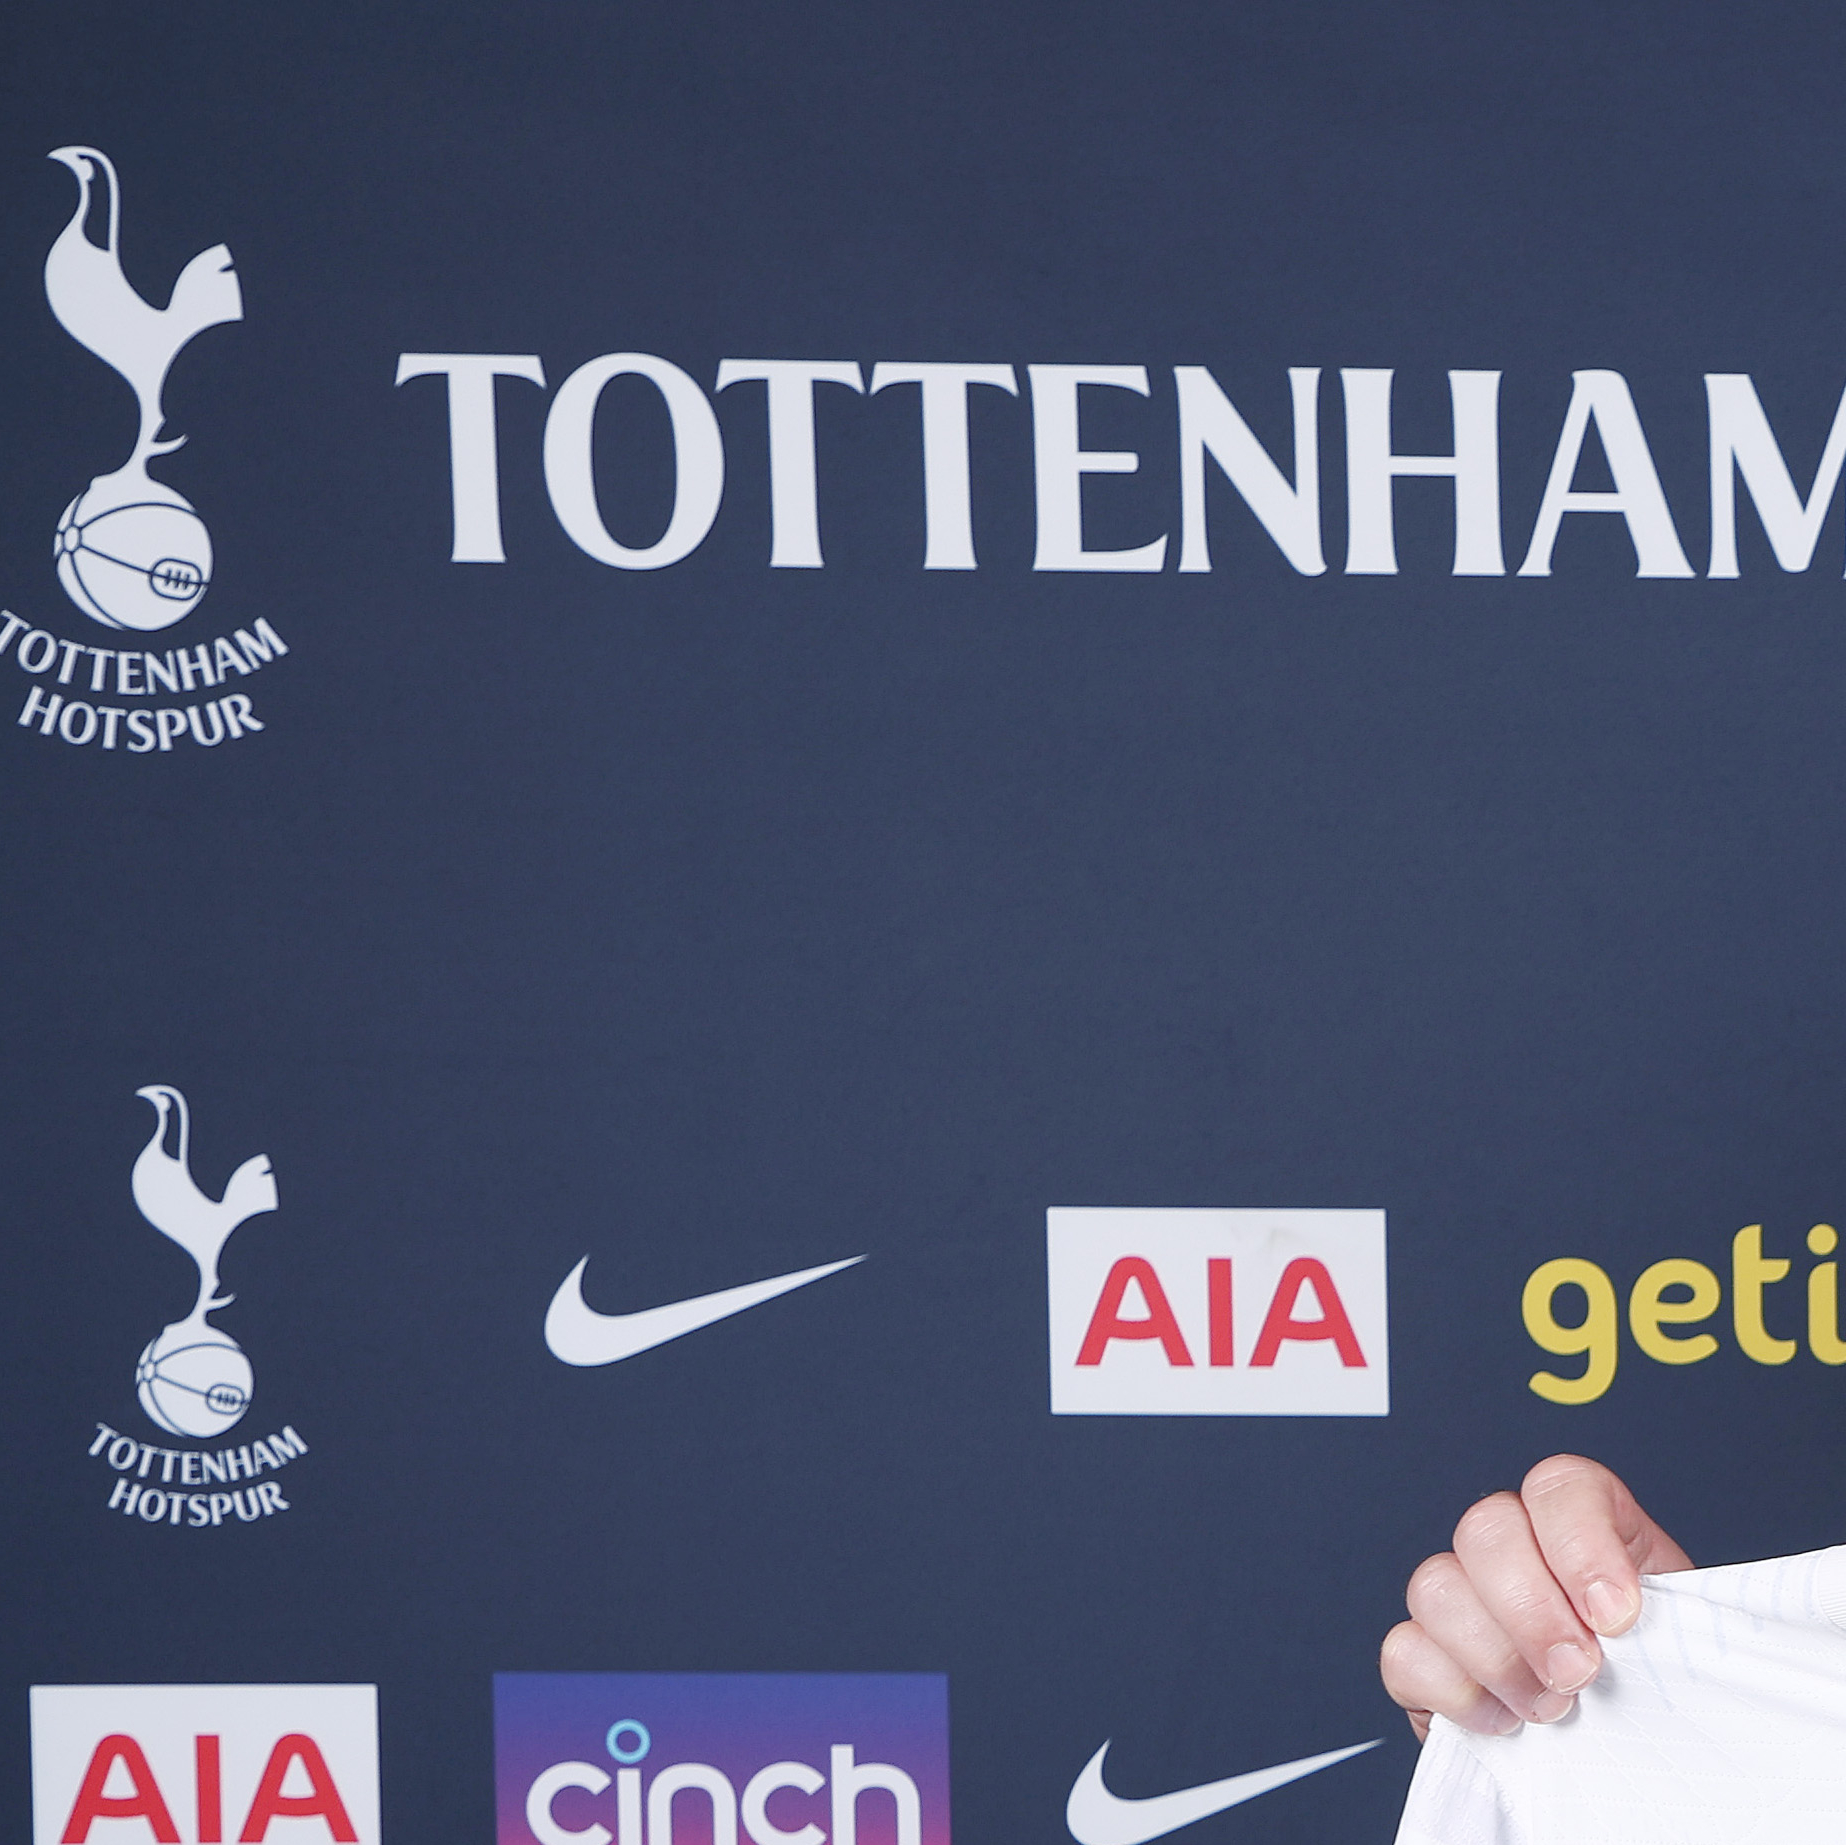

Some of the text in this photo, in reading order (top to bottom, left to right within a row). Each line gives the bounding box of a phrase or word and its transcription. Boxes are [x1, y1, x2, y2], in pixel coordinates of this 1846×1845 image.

[0, 609, 289, 696] TOTTENHAM
[17, 685, 265, 753] HOTSPUR
[1076, 1256, 1367, 1368] AIA
[88, 1422, 308, 1486] TOTTENHAM
[108, 1477, 290, 1527] HOTSPUR
[61, 1733, 358, 1845] AIA
